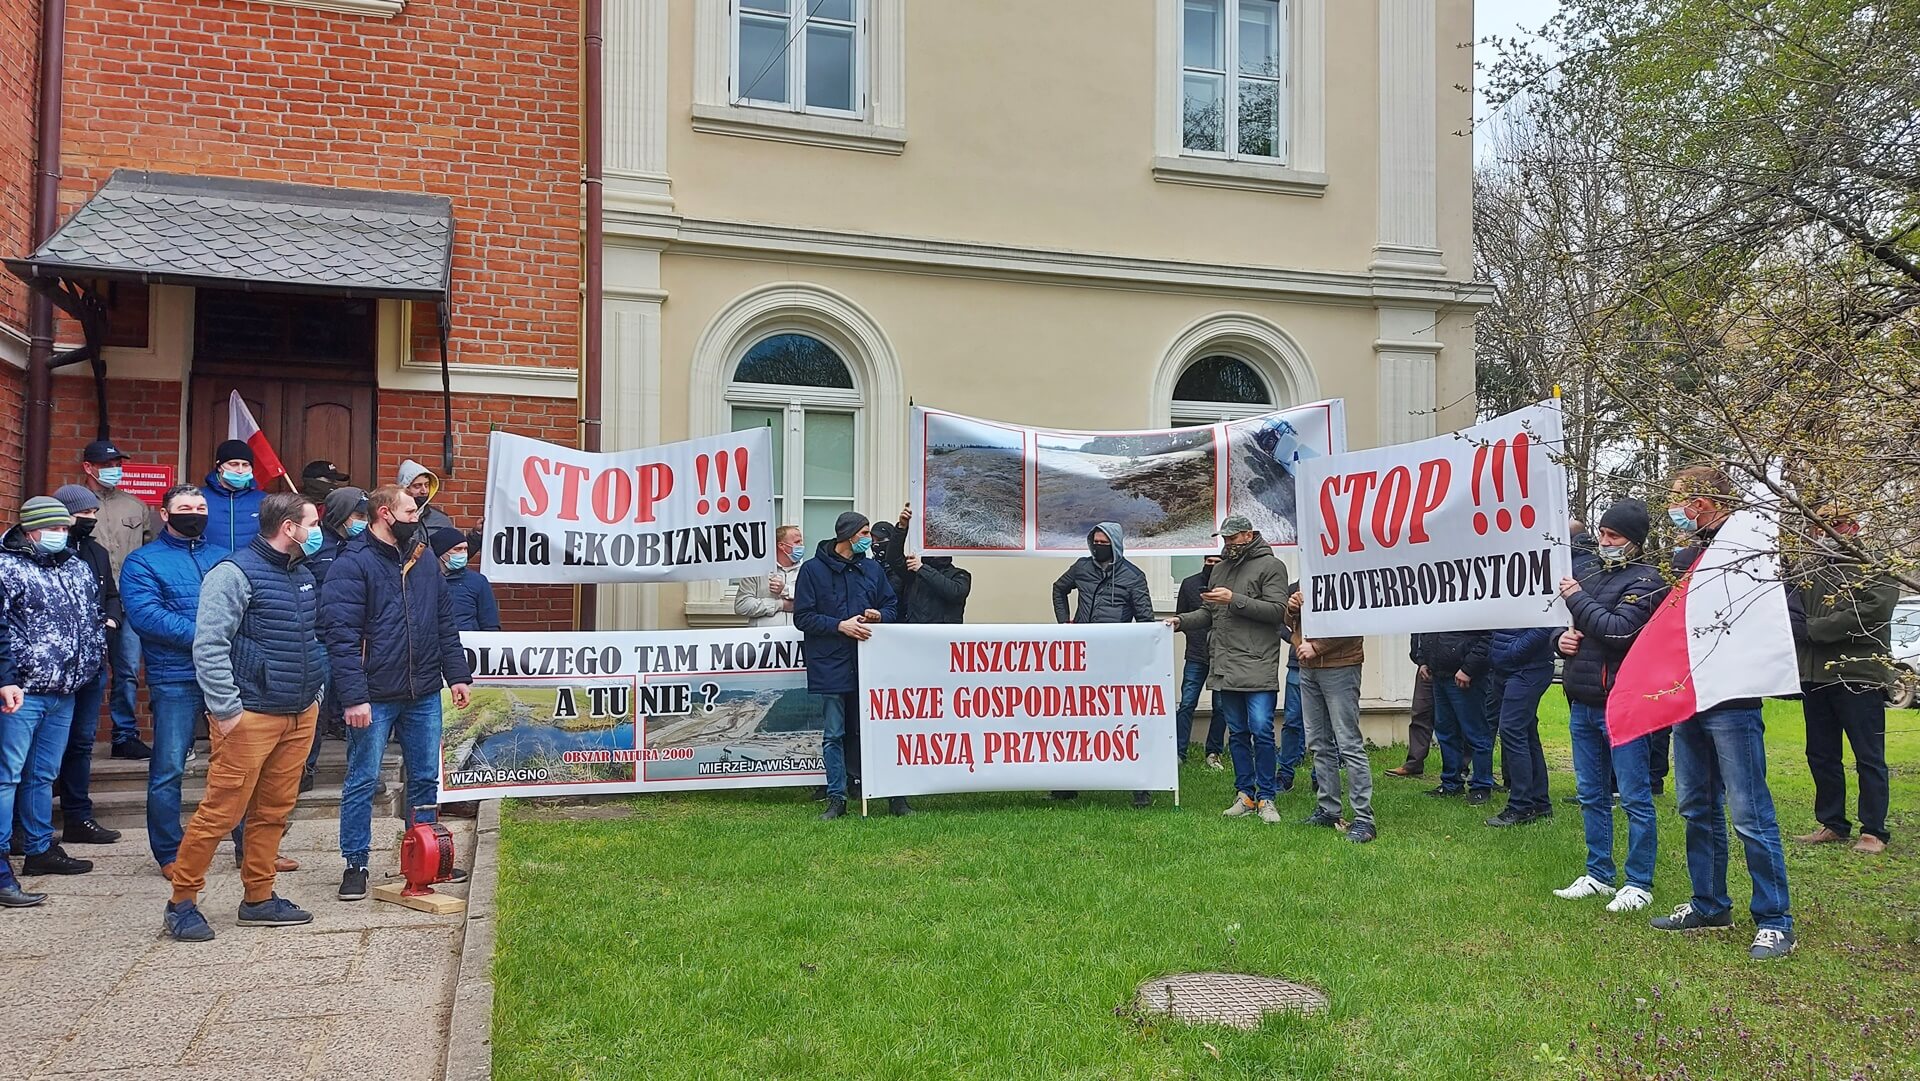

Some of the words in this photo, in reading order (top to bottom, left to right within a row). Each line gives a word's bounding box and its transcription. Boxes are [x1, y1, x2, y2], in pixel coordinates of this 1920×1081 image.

[519, 455, 674, 524] STOP
[695, 447, 751, 515] !!!
[1320, 458, 1452, 556] STOP
[1471, 432, 1536, 535] !!!
[492, 527, 550, 565] dla
[562, 521, 767, 567] EKOBIZNESU
[1311, 549, 1554, 612] EKOTERRORYSTOM
[634, 645, 698, 673] TAM
[950, 641, 1087, 673] NISZCZYCIE
[555, 688, 577, 717] A
[588, 687, 628, 716] TU
[639, 685, 690, 715] NIE
[701, 683, 720, 712] ?
[869, 687, 944, 720] NASZE
[953, 685, 1166, 719] GOSPODARSTWA
[563, 751, 609, 763] OBSZAR
[613, 749, 658, 762] NATURA
[662, 748, 694, 760] 2000
[897, 733, 975, 772] NASZĄ
[984, 724, 1140, 764] PRZYSZŁOŚĆ
[451, 770, 494, 784] WIZNA
[497, 768, 548, 781] BAGNO
[699, 761, 764, 775] MIERZEJA
[767, 756, 826, 771] WIŚLANA
